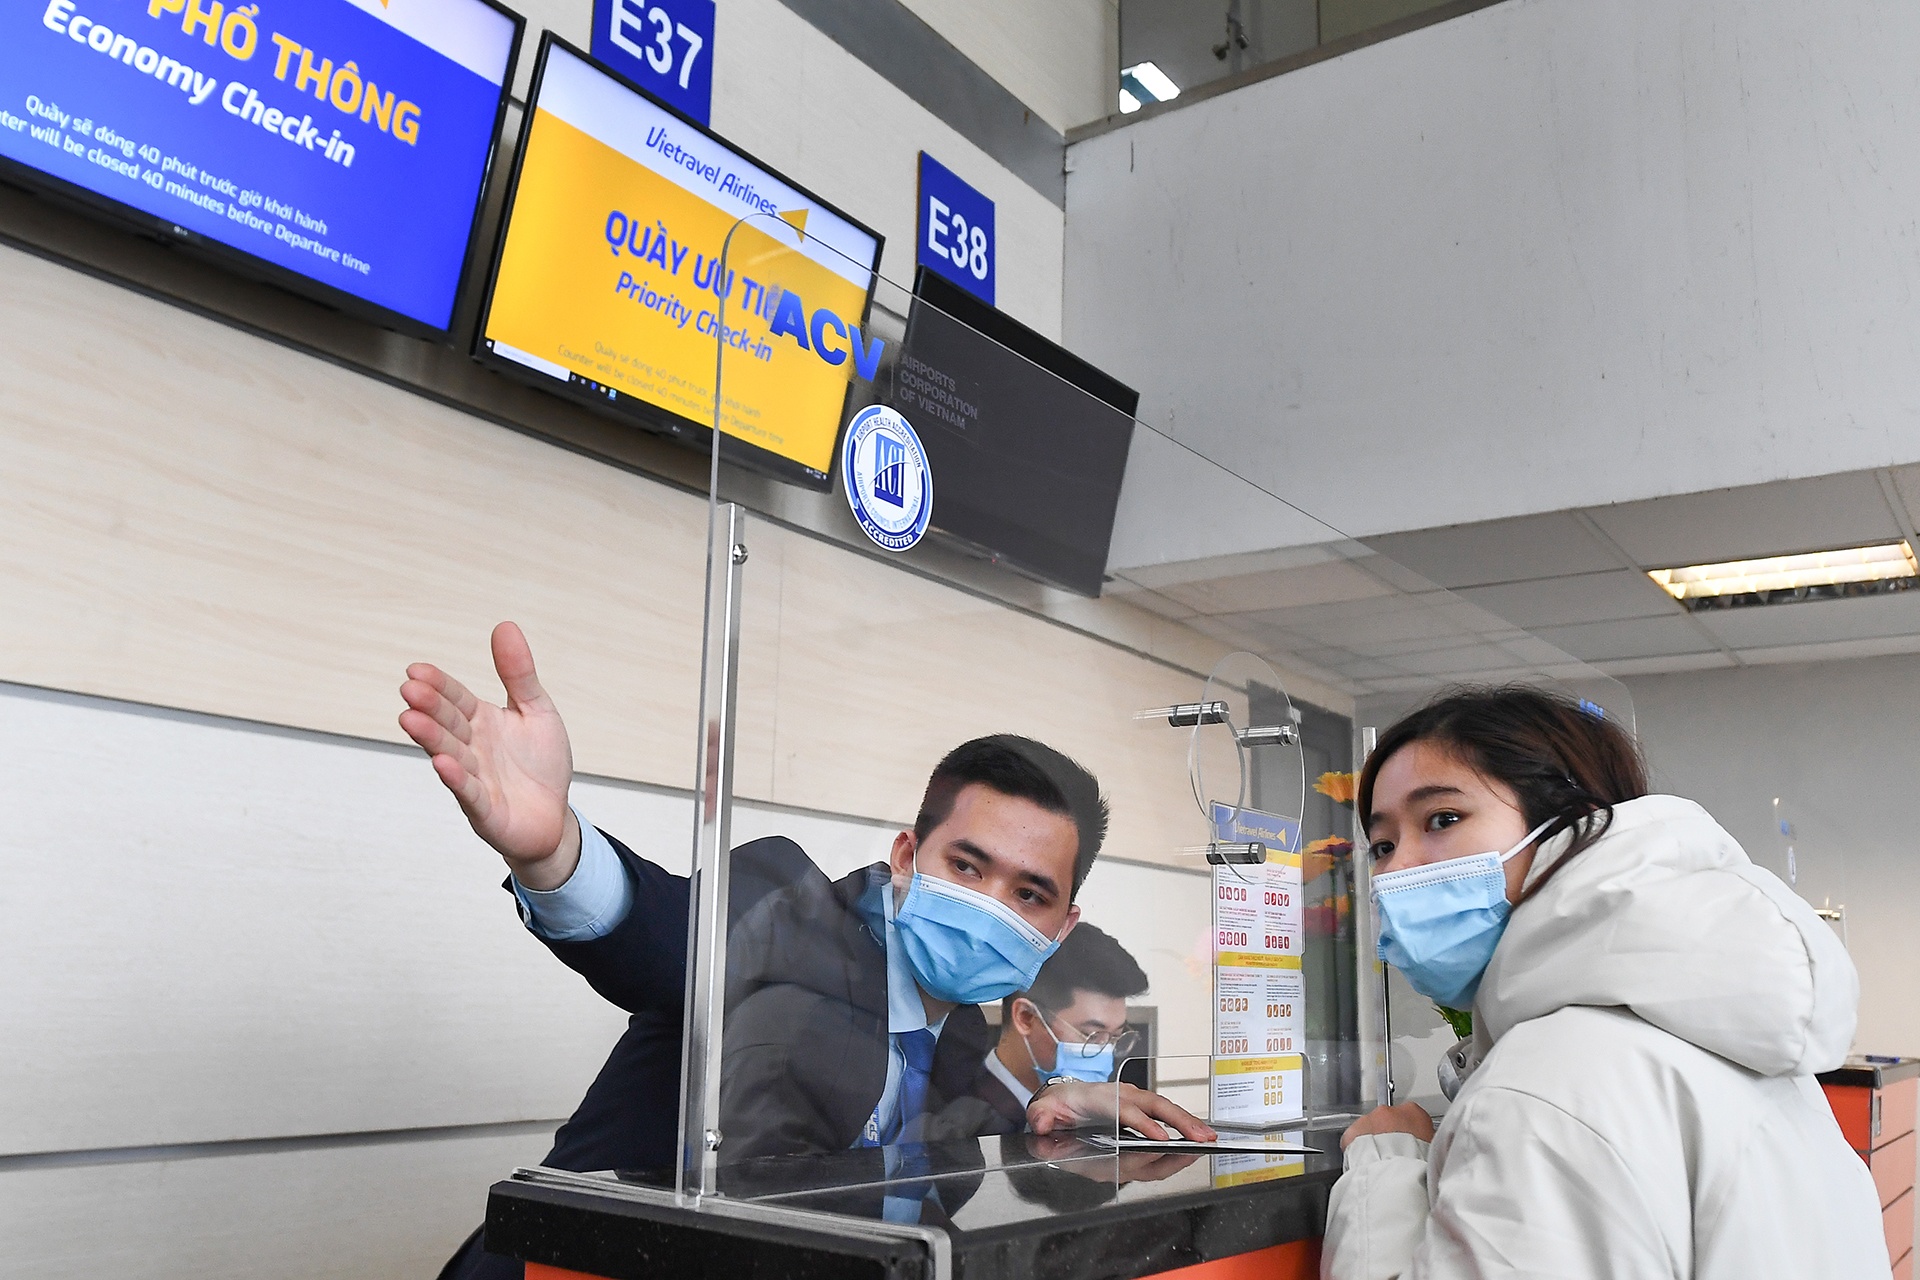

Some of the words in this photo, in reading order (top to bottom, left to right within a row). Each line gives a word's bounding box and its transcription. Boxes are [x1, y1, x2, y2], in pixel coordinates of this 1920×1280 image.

[43, 0, 217, 105] Economy
[221, 81, 355, 168] Check-in
[610, 0, 703, 89] E37
[271, 31, 421, 146] THÔNG
[30, 124, 61, 148] will
[63, 135, 86, 158] be
[87, 148, 140, 180] closed
[141, 169, 165, 190] 40
[165, 181, 225, 215] minutes
[227, 203, 273, 236] before
[274, 223, 340, 263] Departure
[342, 253, 371, 275] time
[138, 144, 161, 164] 40
[162, 156, 198, 181] phút
[646, 127, 720, 184] Vietravel
[718, 173, 778, 217] Airlines
[605, 210, 689, 276] QUẦY
[927, 196, 988, 281] E38
[615, 271, 692, 329] Priority
[696, 310, 773, 363] Check-in
[769, 289, 885, 383] ACV
[900, 370, 978, 419] CORPORATION
[900, 387, 915, 402] OF
[918, 395, 966, 429] VIETNAM
[901, 354, 956, 392] AIRPORTS
[876, 439, 904, 498] ACI
[862, 520, 914, 547] ACCREDITED
